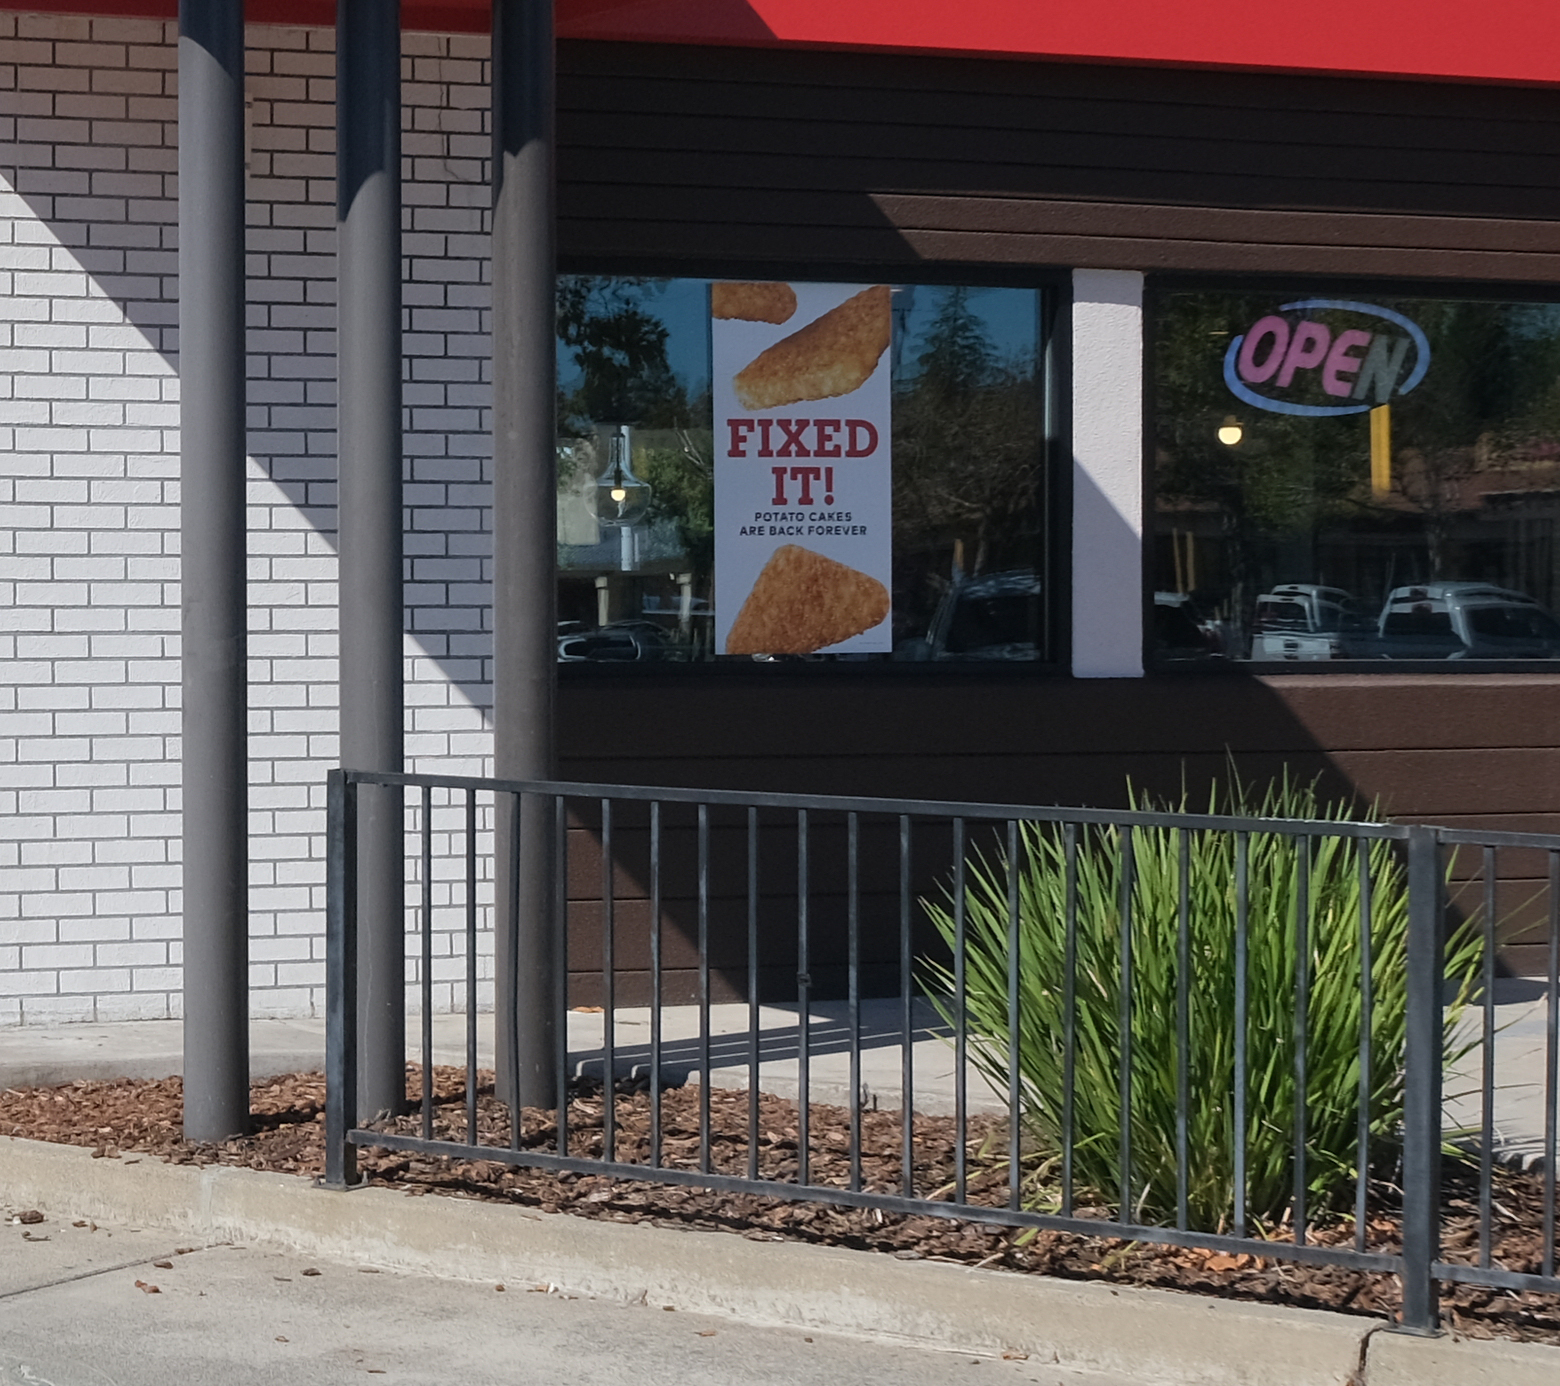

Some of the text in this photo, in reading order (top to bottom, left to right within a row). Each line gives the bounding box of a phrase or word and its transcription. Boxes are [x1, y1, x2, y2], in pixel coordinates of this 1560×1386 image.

[1238, 315, 1411, 402] OPEN
[727, 419, 879, 458] FIXED
[771, 466, 834, 506] IT!
[739, 525, 868, 536] ARE BACK FOREVER
[754, 512, 853, 523] POTATO CAKES
